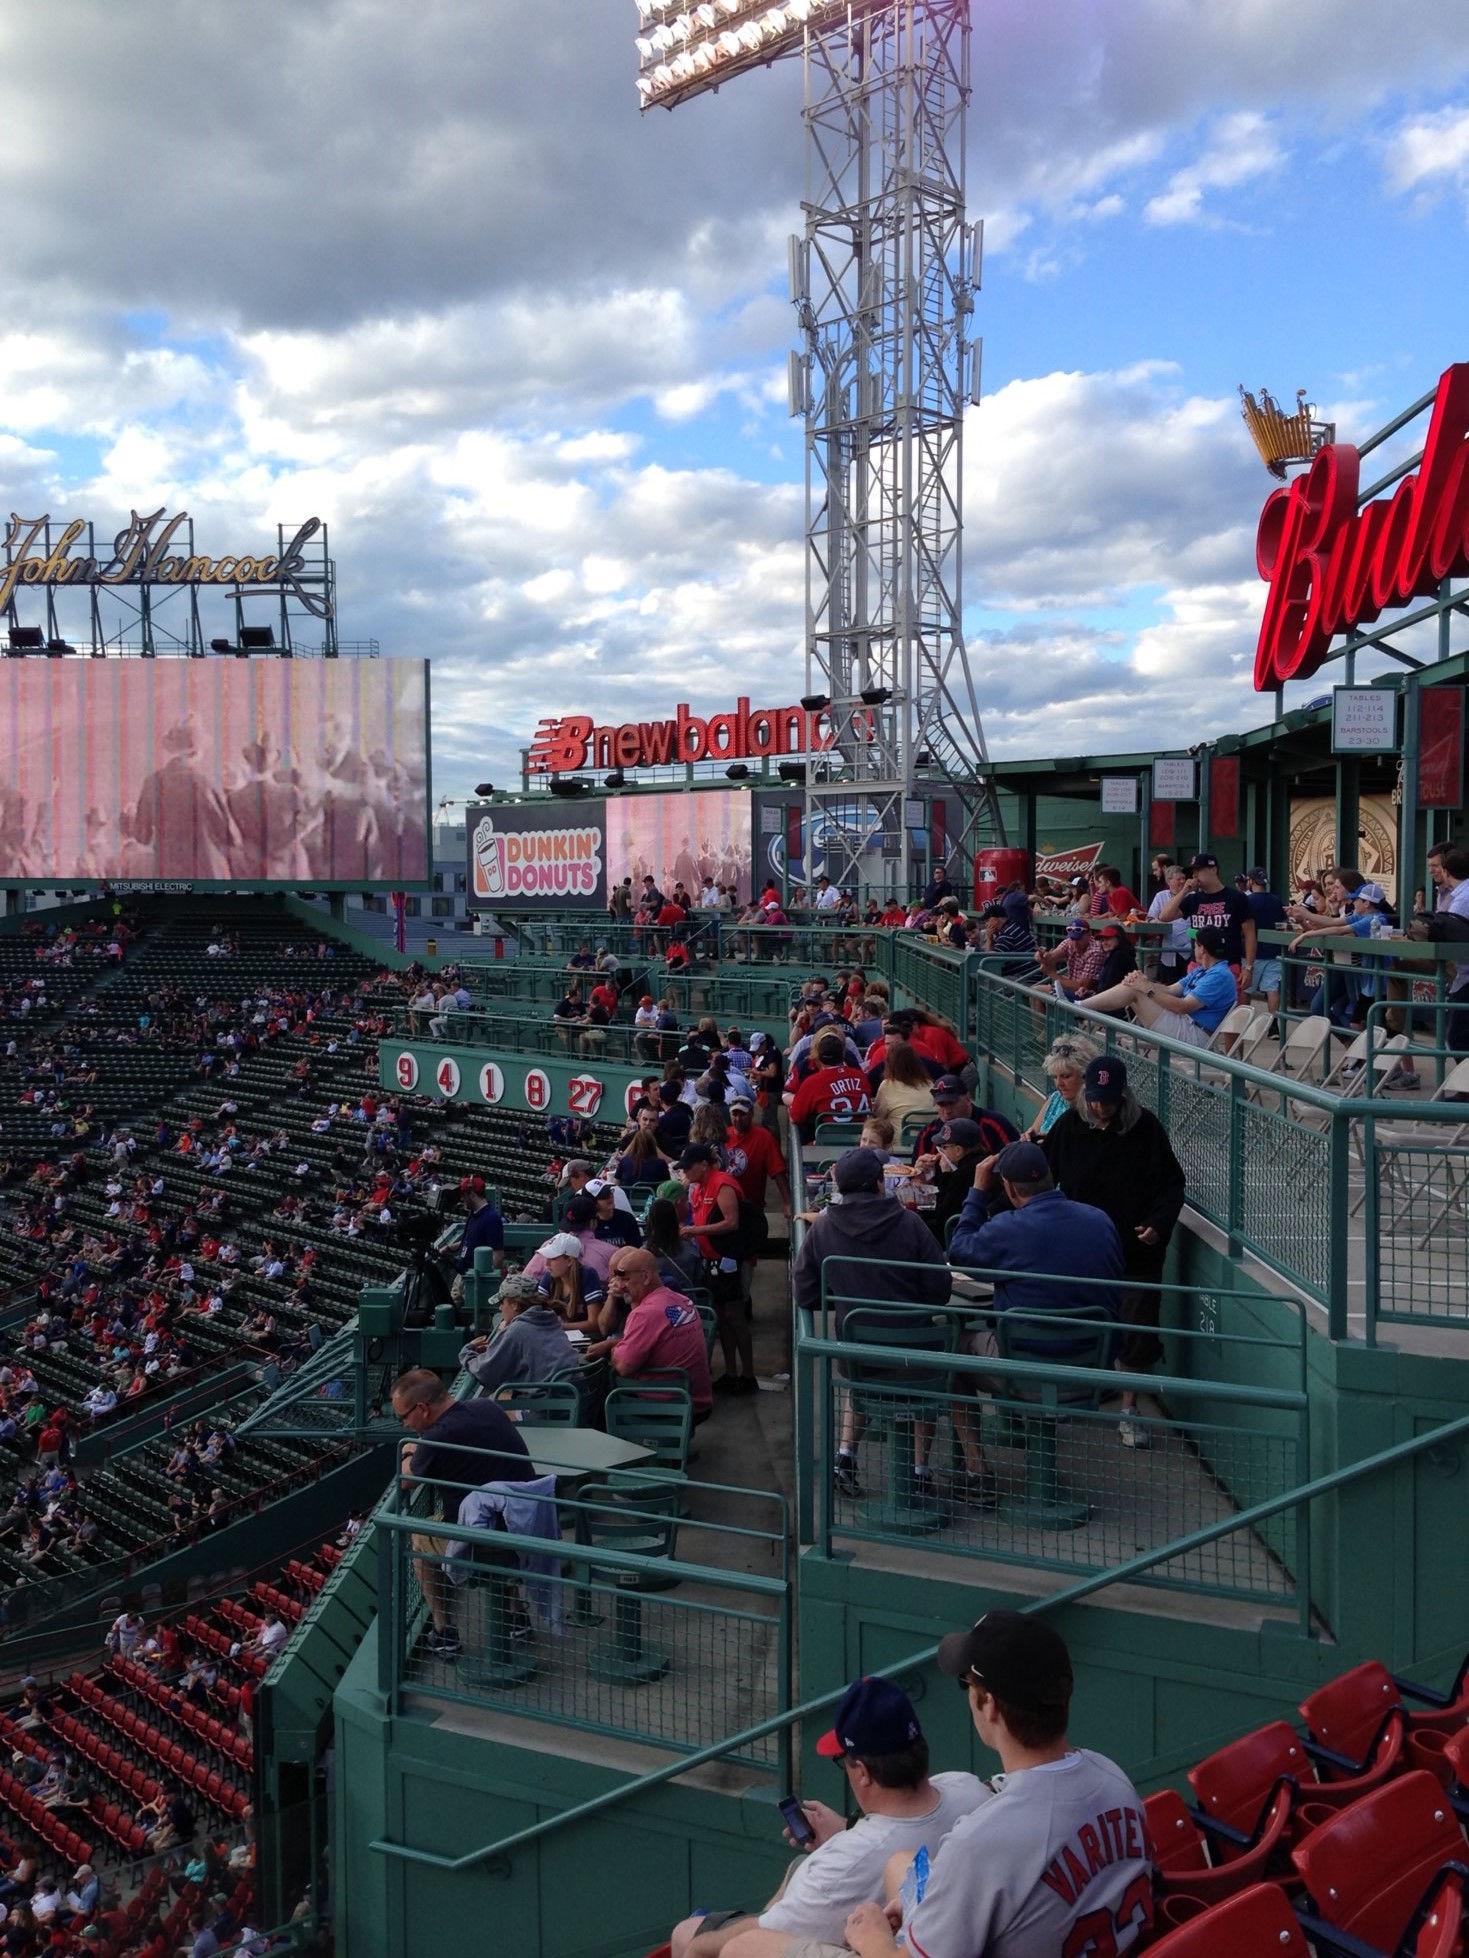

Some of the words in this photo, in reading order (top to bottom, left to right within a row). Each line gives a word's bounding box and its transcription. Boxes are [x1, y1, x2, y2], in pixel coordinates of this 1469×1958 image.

[0, 512, 98, 616] John
[97, 507, 334, 619] Hancock
[593, 720, 677, 769] new
[1348, 737, 1380, 745] 23-30
[507, 832, 598, 863] DUNKIN'
[507, 862, 594, 891] DONUTS
[1036, 857, 1099, 873] dweiser
[109, 882, 153, 890] MITSUBISHI
[154, 882, 192, 891] ELECTRIC
[1197, 902, 1226, 915] FREE
[1191, 914, 1231, 928] BRADY
[399, 1058, 413, 1087] 9
[439, 1063, 455, 1093] 4
[485, 1068, 495, 1099] 1
[527, 1074, 544, 1107] 8
[568, 1078, 604, 1113] 27
[830, 1078, 861, 1096] ORTIZ
[830, 1094, 872, 1123] 34
